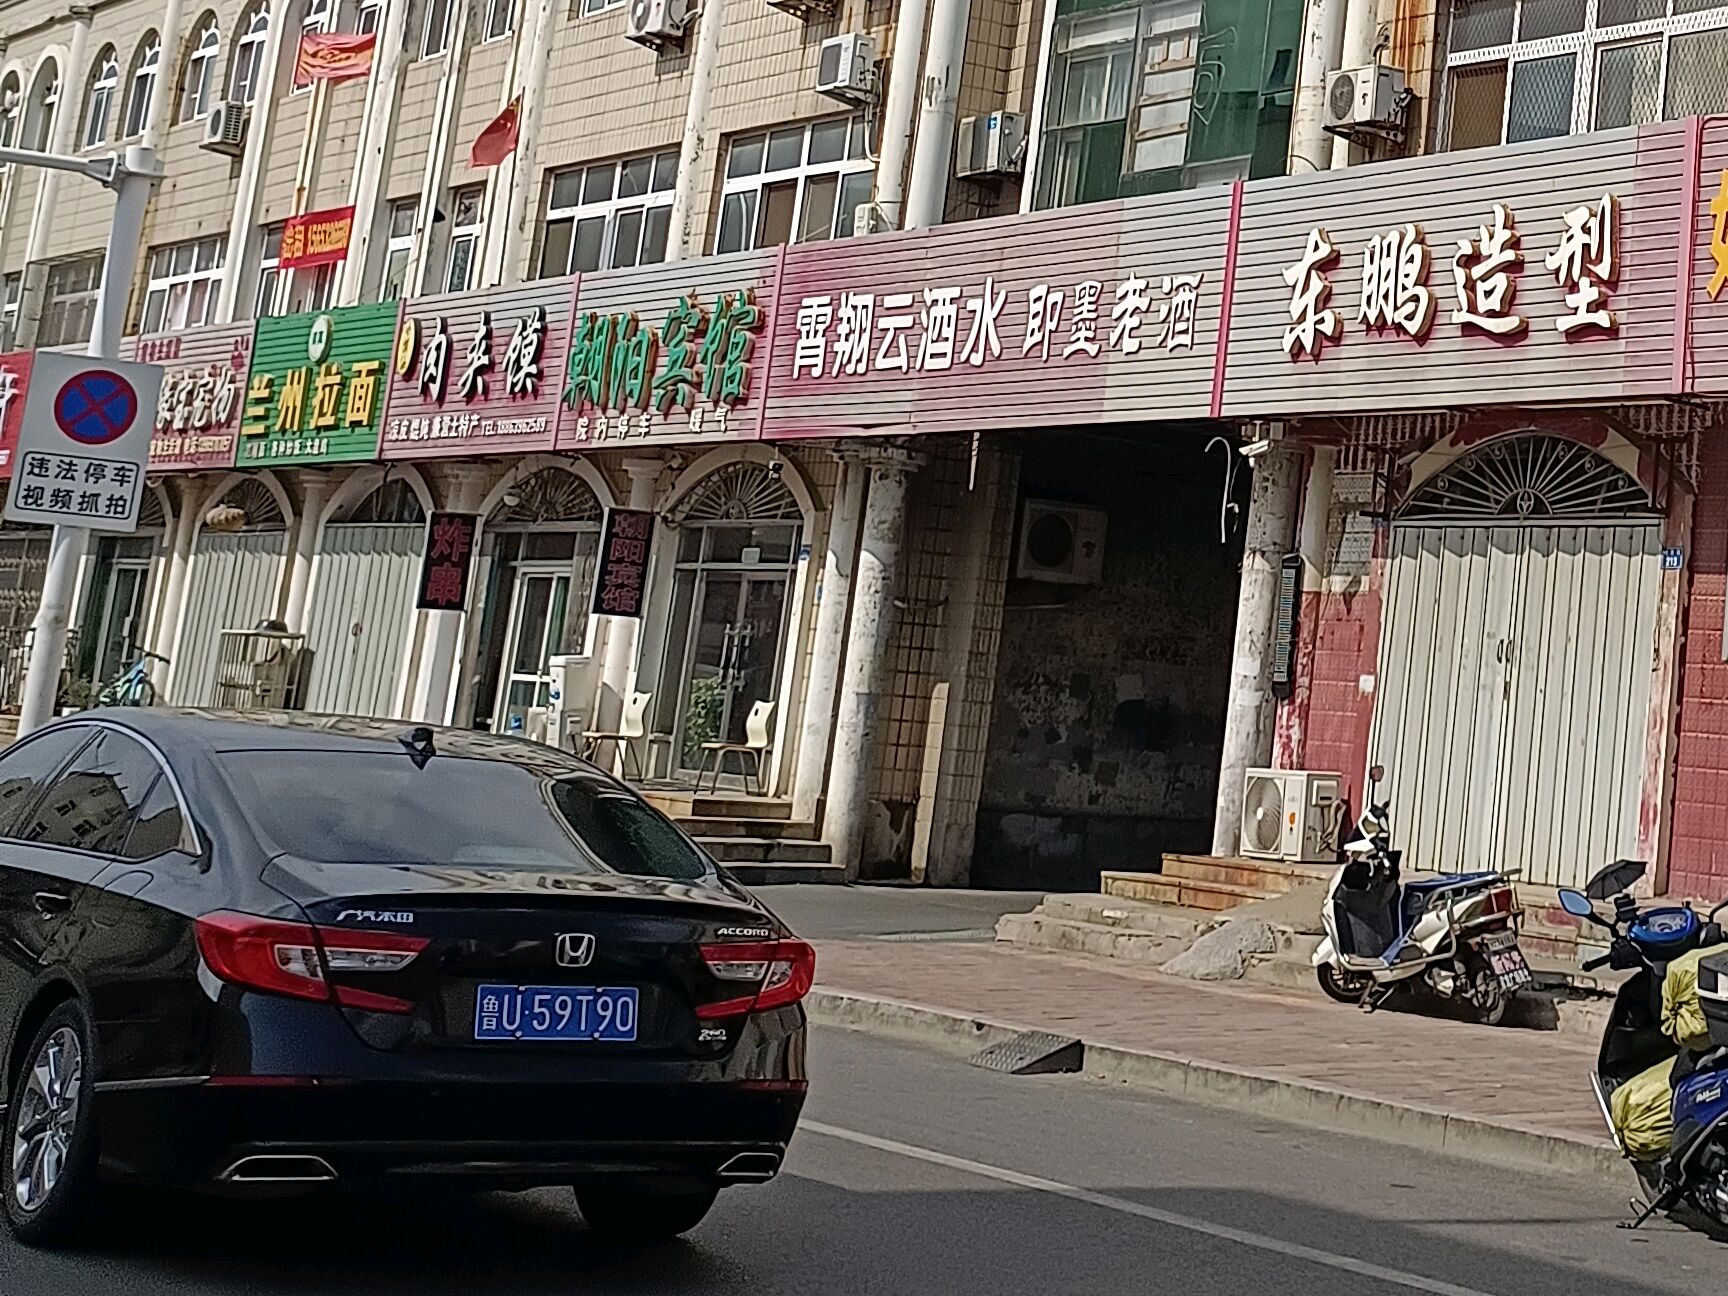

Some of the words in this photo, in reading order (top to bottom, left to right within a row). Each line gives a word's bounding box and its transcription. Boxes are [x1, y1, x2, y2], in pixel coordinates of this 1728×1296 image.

[1282, 192, 1620, 356] 东鹏造型
[418, 307, 543, 402] 肉夹馍
[561, 289, 760, 411] 朝阳宾馆
[792, 276, 1008, 380] 霄翔云酒水
[1023, 272, 1204, 362] 即墨老酒
[241, 360, 380, 435] 兰州拉面
[576, 413, 650, 441] 院内停车
[22, 484, 128, 516] 视频抓拍
[27, 456, 135, 487] 违法停车
[426, 517, 472, 606] 炸串
[601, 513, 650, 613] 朝阳宾馆
[716, 927, 769, 937] ACCORD
